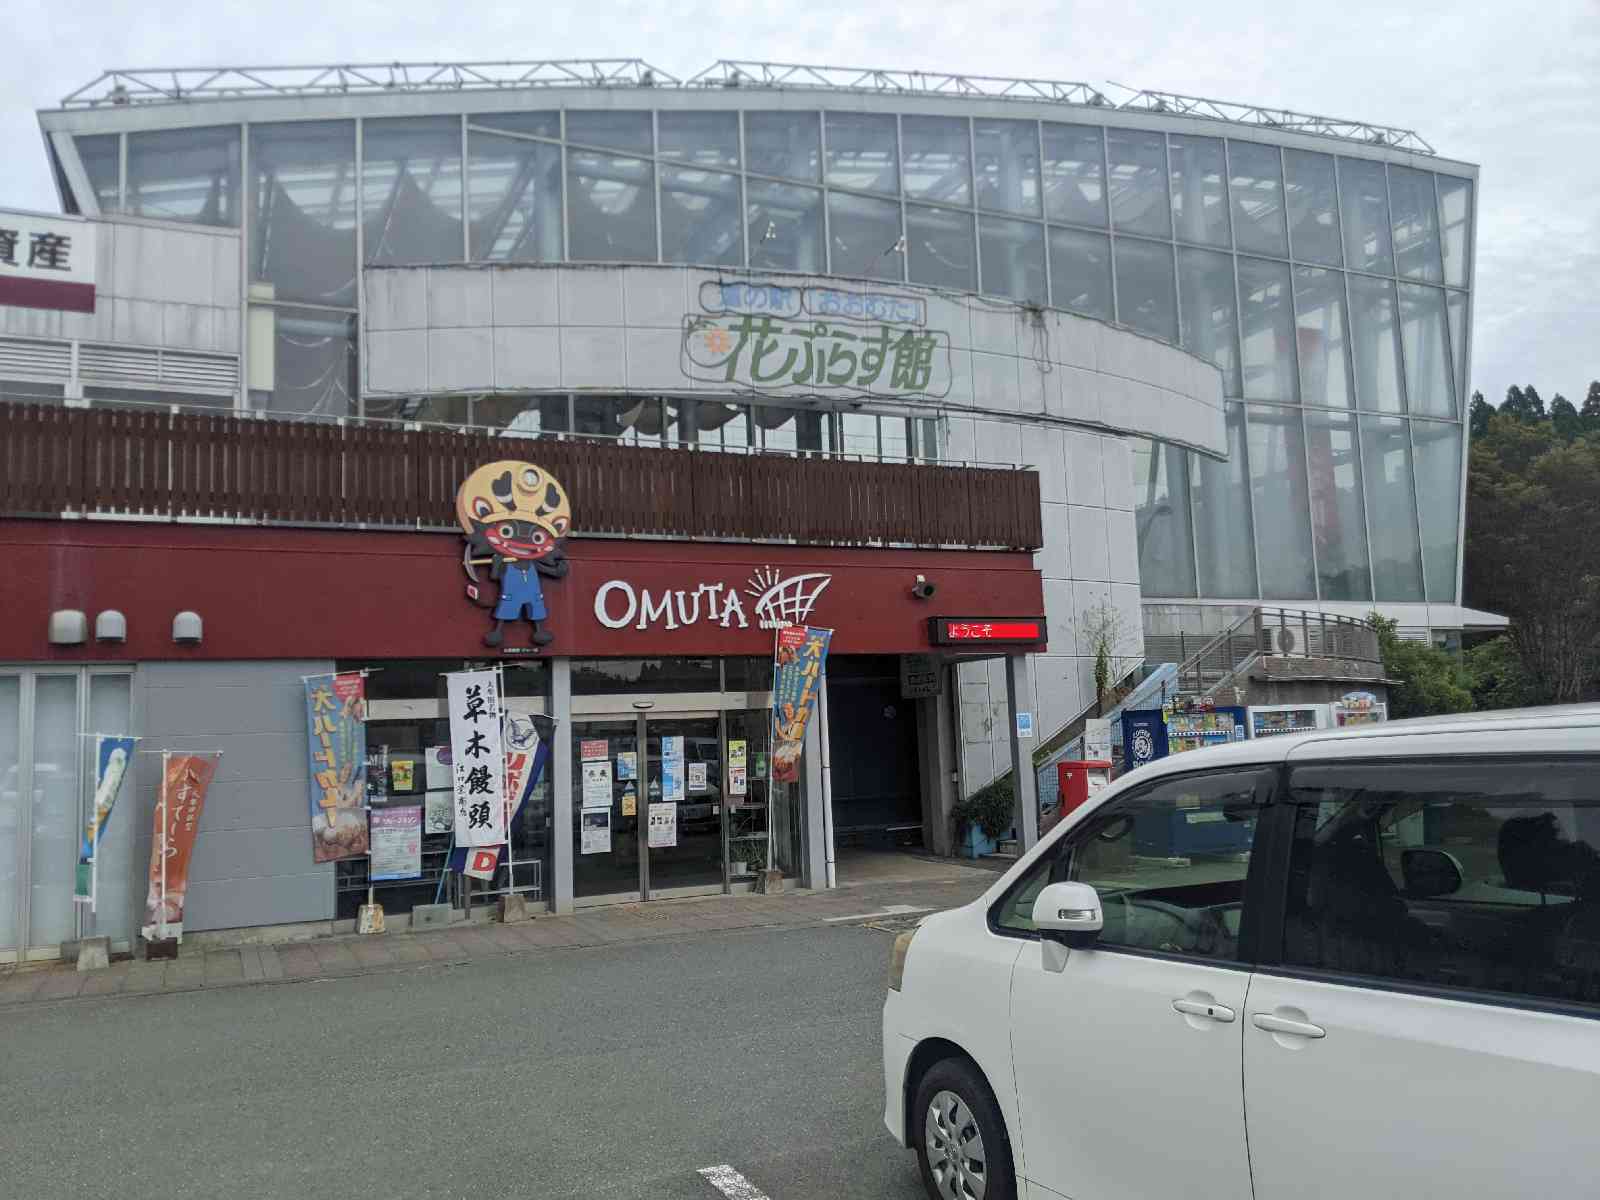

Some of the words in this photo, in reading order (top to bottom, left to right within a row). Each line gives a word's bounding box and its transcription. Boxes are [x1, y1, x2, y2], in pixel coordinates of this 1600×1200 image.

[725, 314, 937, 390] 花ぷらす館
[594, 580, 749, 630] OMUTA
[948, 623, 993, 638] ようこそ
[463, 684, 495, 830] 草木饅頭
